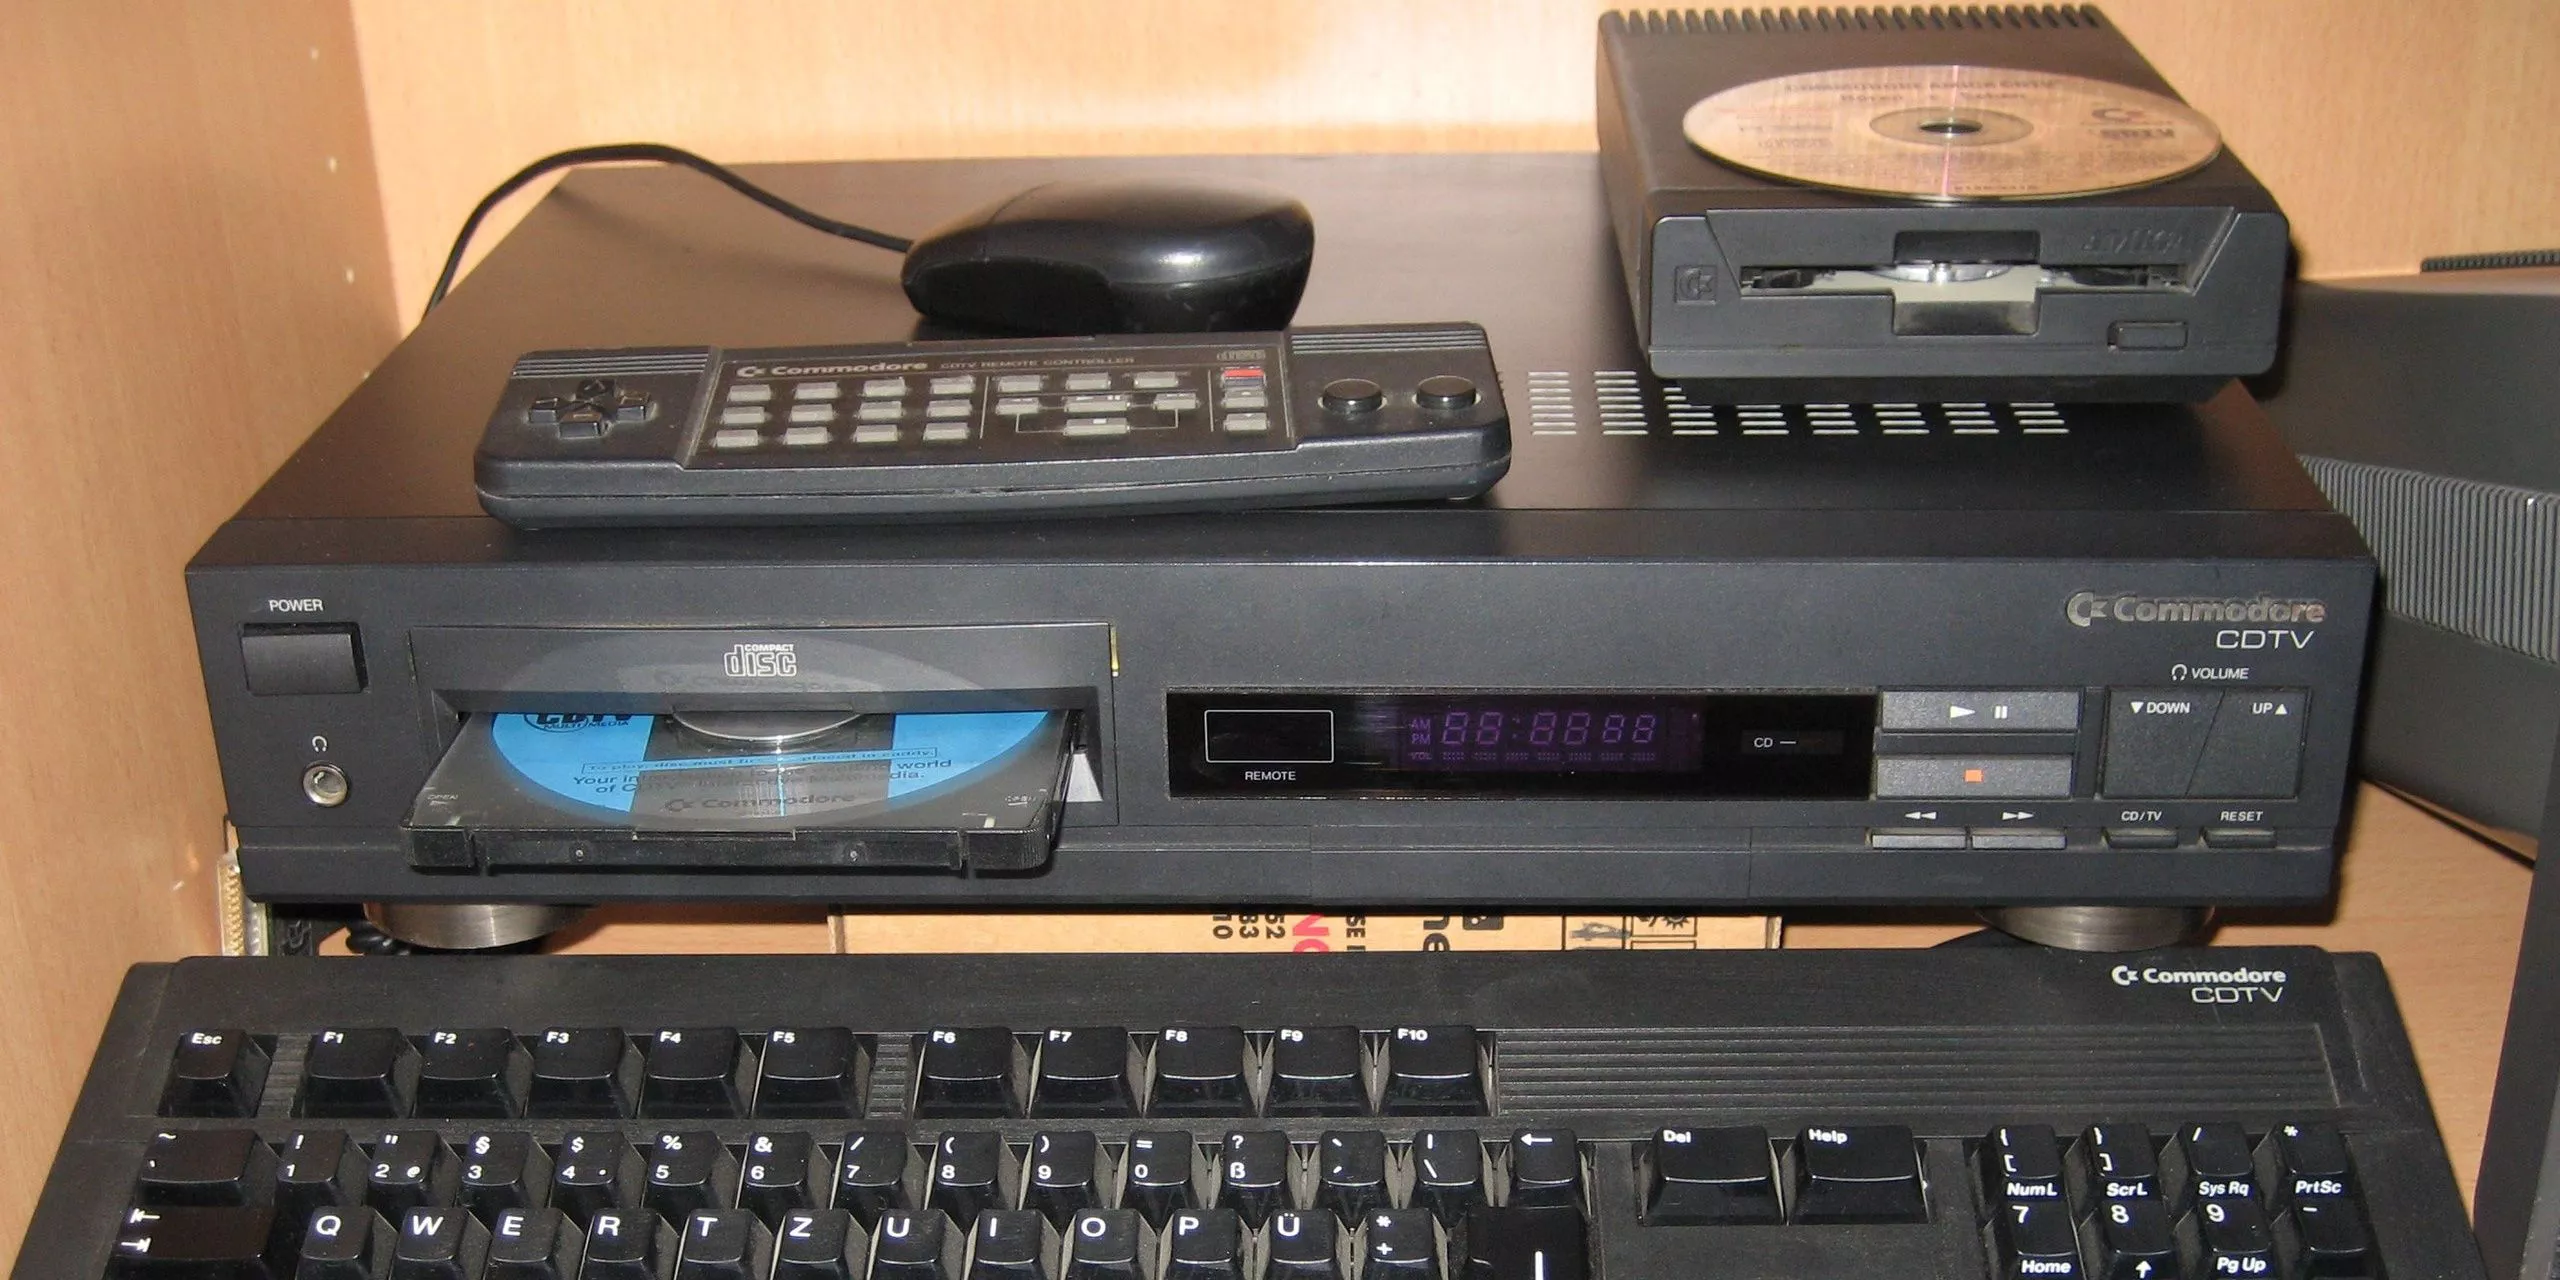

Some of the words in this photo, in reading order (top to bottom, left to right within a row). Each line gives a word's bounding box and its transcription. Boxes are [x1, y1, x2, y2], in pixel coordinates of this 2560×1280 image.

[771, 361, 929, 376] Commodore
[980, 359, 1039, 369] REMOTE
[1042, 356, 1135, 367] CONTROLLER
[269, 600, 323, 612] POWER
[2112, 597, 2327, 624] Commodore
[744, 643, 795, 652] COMPACT
[2216, 630, 2315, 650] CDTV
[723, 644, 797, 677] disc
[2191, 668, 2249, 680] VOLUME
[2146, 702, 2191, 714] DOWN
[2252, 702, 2274, 714] UP
[1410, 718, 1431, 730] AM
[1411, 733, 1431, 745] PM
[1753, 737, 1774, 749] CD
[573, 775, 618, 786] Your
[897, 759, 952, 769] world
[1244, 770, 1296, 782] REMOTE
[596, 783, 617, 794] of
[2120, 810, 2163, 822] CD/TV
[2220, 810, 2264, 822] RESET
[2142, 967, 2287, 984] Commodore
[2191, 986, 2283, 1003] CDTV
[191, 1032, 222, 1045] Esc
[322, 1031, 344, 1044] F1
[434, 1031, 457, 1045] F2
[546, 1031, 570, 1044] F3
[659, 1030, 682, 1044] F4
[772, 1030, 795, 1044] F5
[932, 1030, 956, 1044] F6
[1049, 1029, 1073, 1043] F7
[1165, 1029, 1188, 1043] F8
[1280, 1028, 1304, 1042] F9
[1397, 1028, 1428, 1041] F10
[662, 1134, 683, 1151] %
[754, 1136, 773, 1153] &
[1231, 1134, 1244, 1149] ?
[1662, 1129, 1692, 1144] Del
[1808, 1128, 1848, 1145] Help
[474, 1135, 491, 1155] §
[571, 1136, 584, 1154] $
[374, 1163, 390, 1178] 2
[467, 1164, 482, 1180] 3
[562, 1165, 576, 1180] 4
[655, 1164, 670, 1180] 5
[750, 1165, 765, 1180] 6
[846, 1164, 861, 1179] 7
[941, 1164, 956, 1180] 8
[1037, 1164, 1052, 1180] 9
[1134, 1163, 1149, 1179] 0
[2198, 1180, 2226, 1197] Sys
[2228, 1180, 2250, 1197] Rq
[2295, 1179, 2342, 1194] PrtSc
[2012, 1205, 2030, 1224] 7
[2111, 1204, 2130, 1224] 8
[2206, 1203, 2225, 1223] 9
[315, 1215, 342, 1237] Q
[412, 1215, 444, 1236] W
[502, 1215, 524, 1237] E
[597, 1215, 621, 1237] R
[696, 1216, 719, 1237] T
[789, 1216, 813, 1238] Z
[886, 1216, 911, 1238] U
[1080, 1216, 1107, 1238] O
[1178, 1215, 1200, 1236] P
[1277, 1212, 1300, 1237] Ü
[2021, 1259, 2072, 1274] Home
[2216, 1256, 2240, 1274] Pg
[2241, 1257, 2267, 1274] Up
